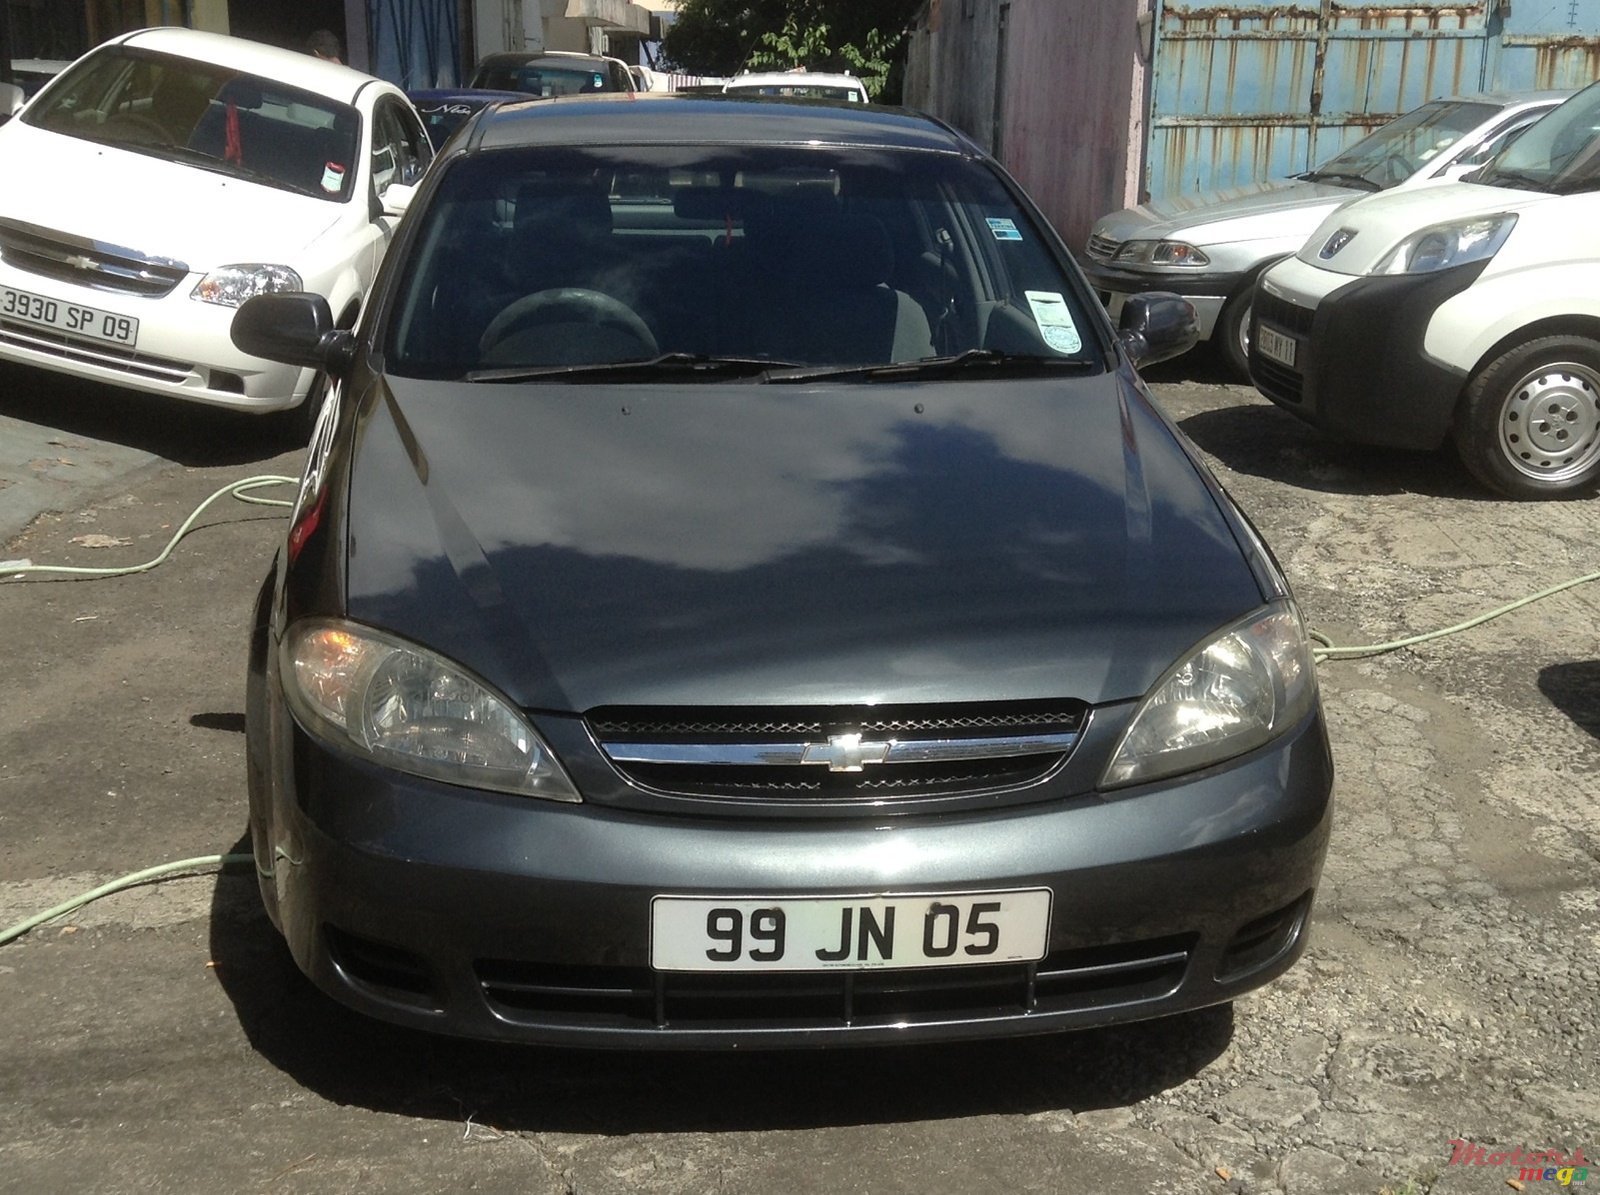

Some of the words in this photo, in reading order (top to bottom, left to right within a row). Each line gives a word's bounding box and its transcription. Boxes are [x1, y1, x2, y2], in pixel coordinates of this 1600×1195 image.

[3, 291, 58, 323] 3930
[66, 307, 94, 330] SP
[102, 315, 131, 340] 09
[706, 907, 786, 961] 99
[815, 906, 895, 961] JN
[922, 902, 1001, 958] 05
